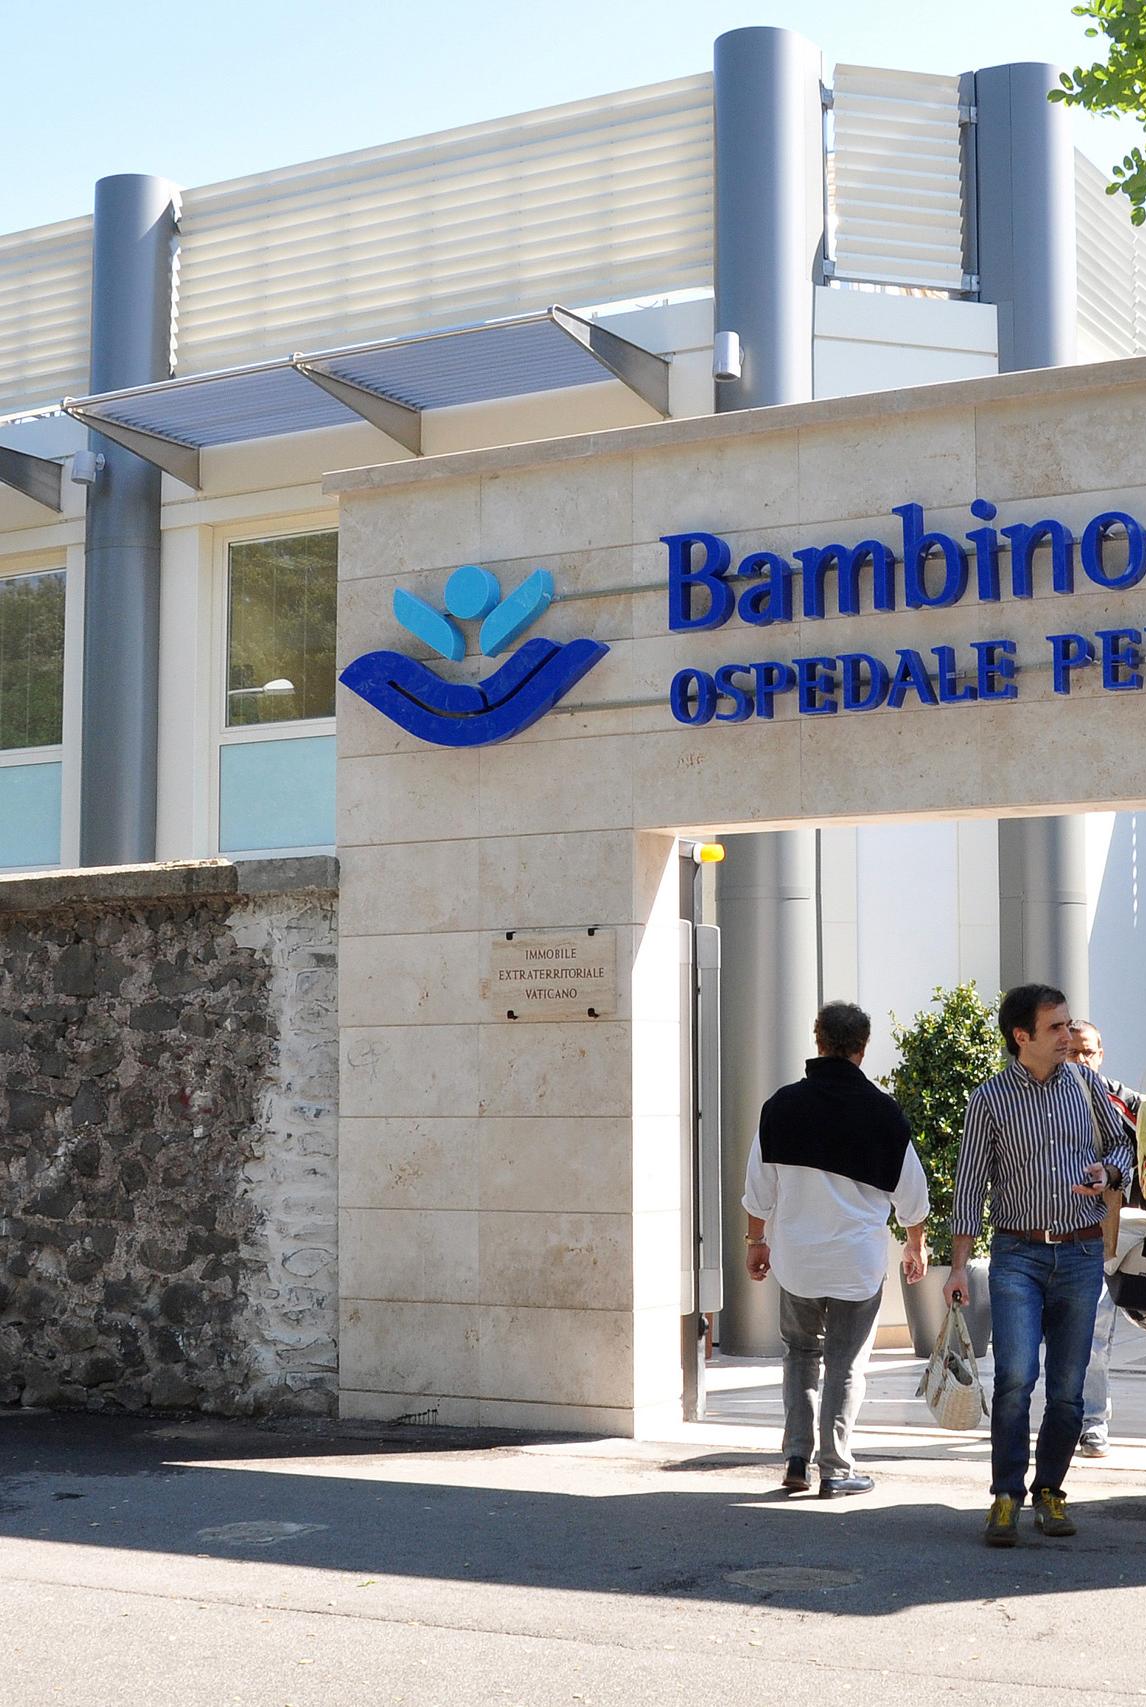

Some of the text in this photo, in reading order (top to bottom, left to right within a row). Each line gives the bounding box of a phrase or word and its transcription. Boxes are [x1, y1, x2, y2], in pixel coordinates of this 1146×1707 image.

[670, 640, 1018, 725] OSPEDALE
[525, 949, 577, 960] IMMOBILE
[499, 967, 604, 981] EXTRATERRITORIALE
[525, 988, 577, 999] VATICANO
